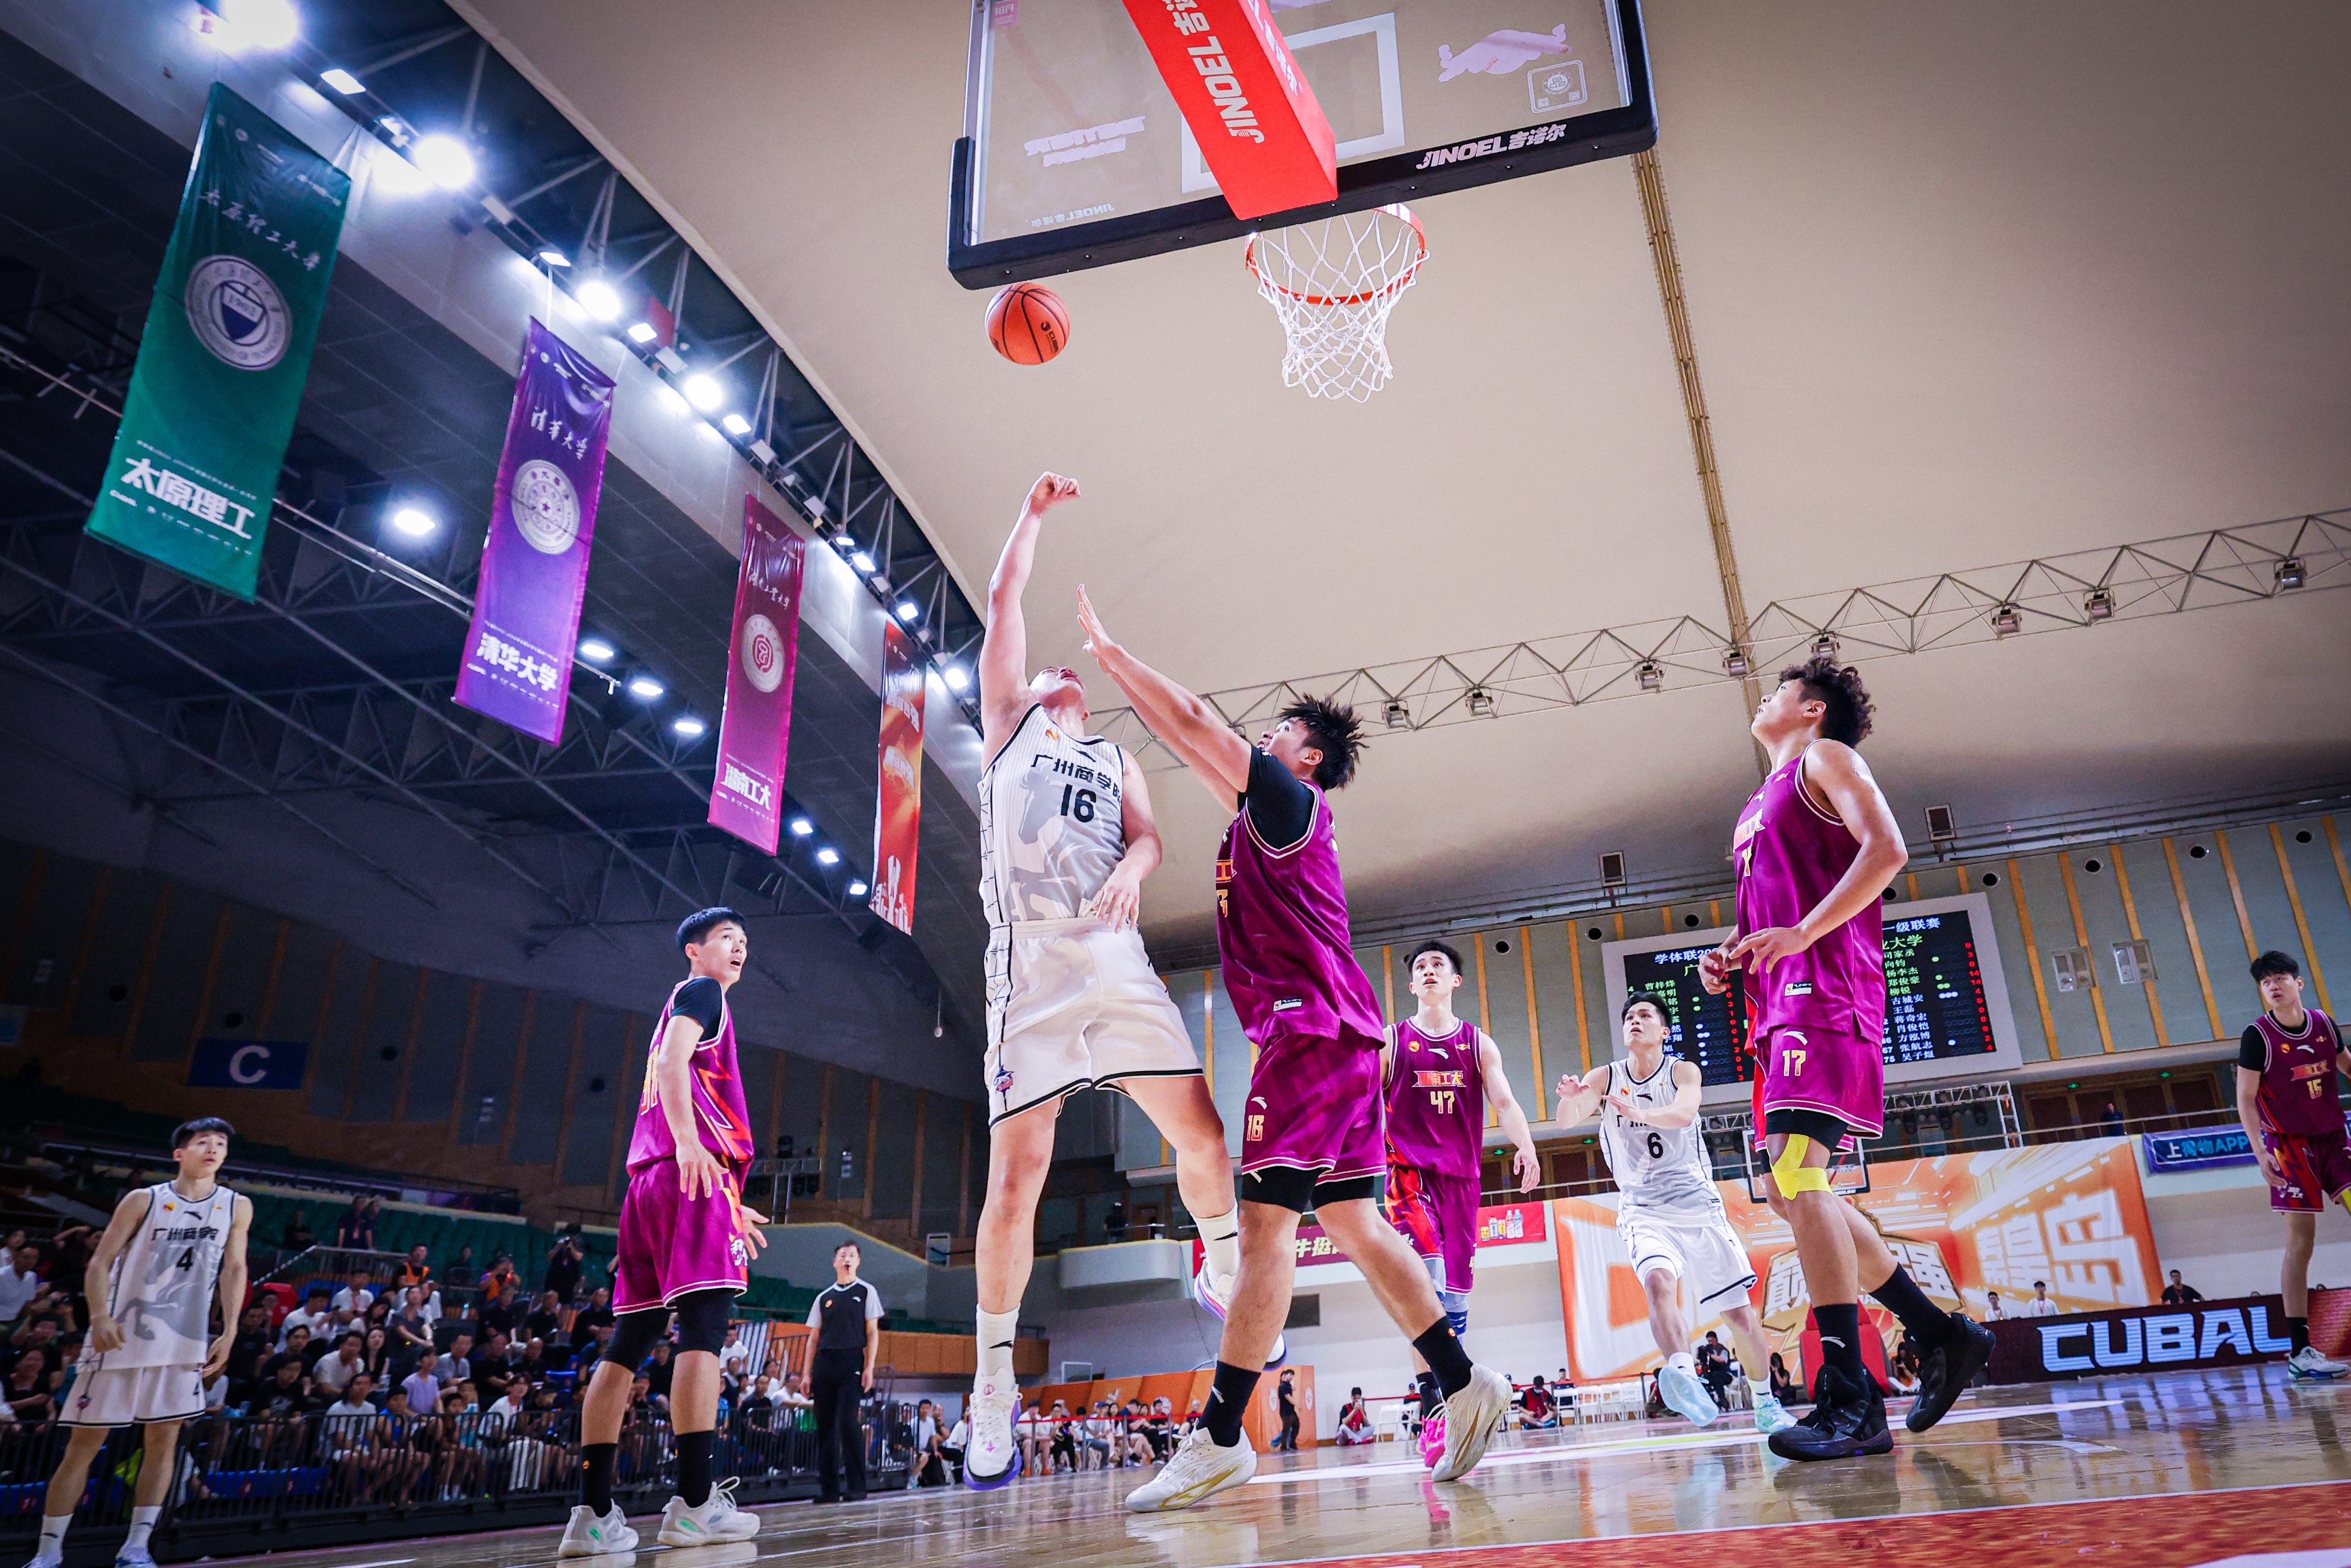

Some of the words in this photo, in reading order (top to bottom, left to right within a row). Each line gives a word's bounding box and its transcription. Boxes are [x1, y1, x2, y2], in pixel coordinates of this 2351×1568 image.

[1187, 35, 1264, 143] JINOEL
[1416, 136, 1507, 169] JINOEL
[1508, 124, 1567, 150] 吉诺尔
[121, 458, 255, 539] 太原理工
[476, 632, 558, 691] 清华大学
[720, 762, 771, 810] 湖南工大
[1060, 783, 1097, 822] 16
[230, 1045, 270, 1083] C
[1783, 1050, 1806, 1076] 17
[1884, 1055, 1896, 1064] 75
[1430, 1091, 1455, 1114] 47
[2306, 1079, 2323, 1099] 15
[1648, 1133, 1663, 1159] 6
[176, 1247, 193, 1271] 4
[2037, 1306, 2293, 1372] CUBAL
